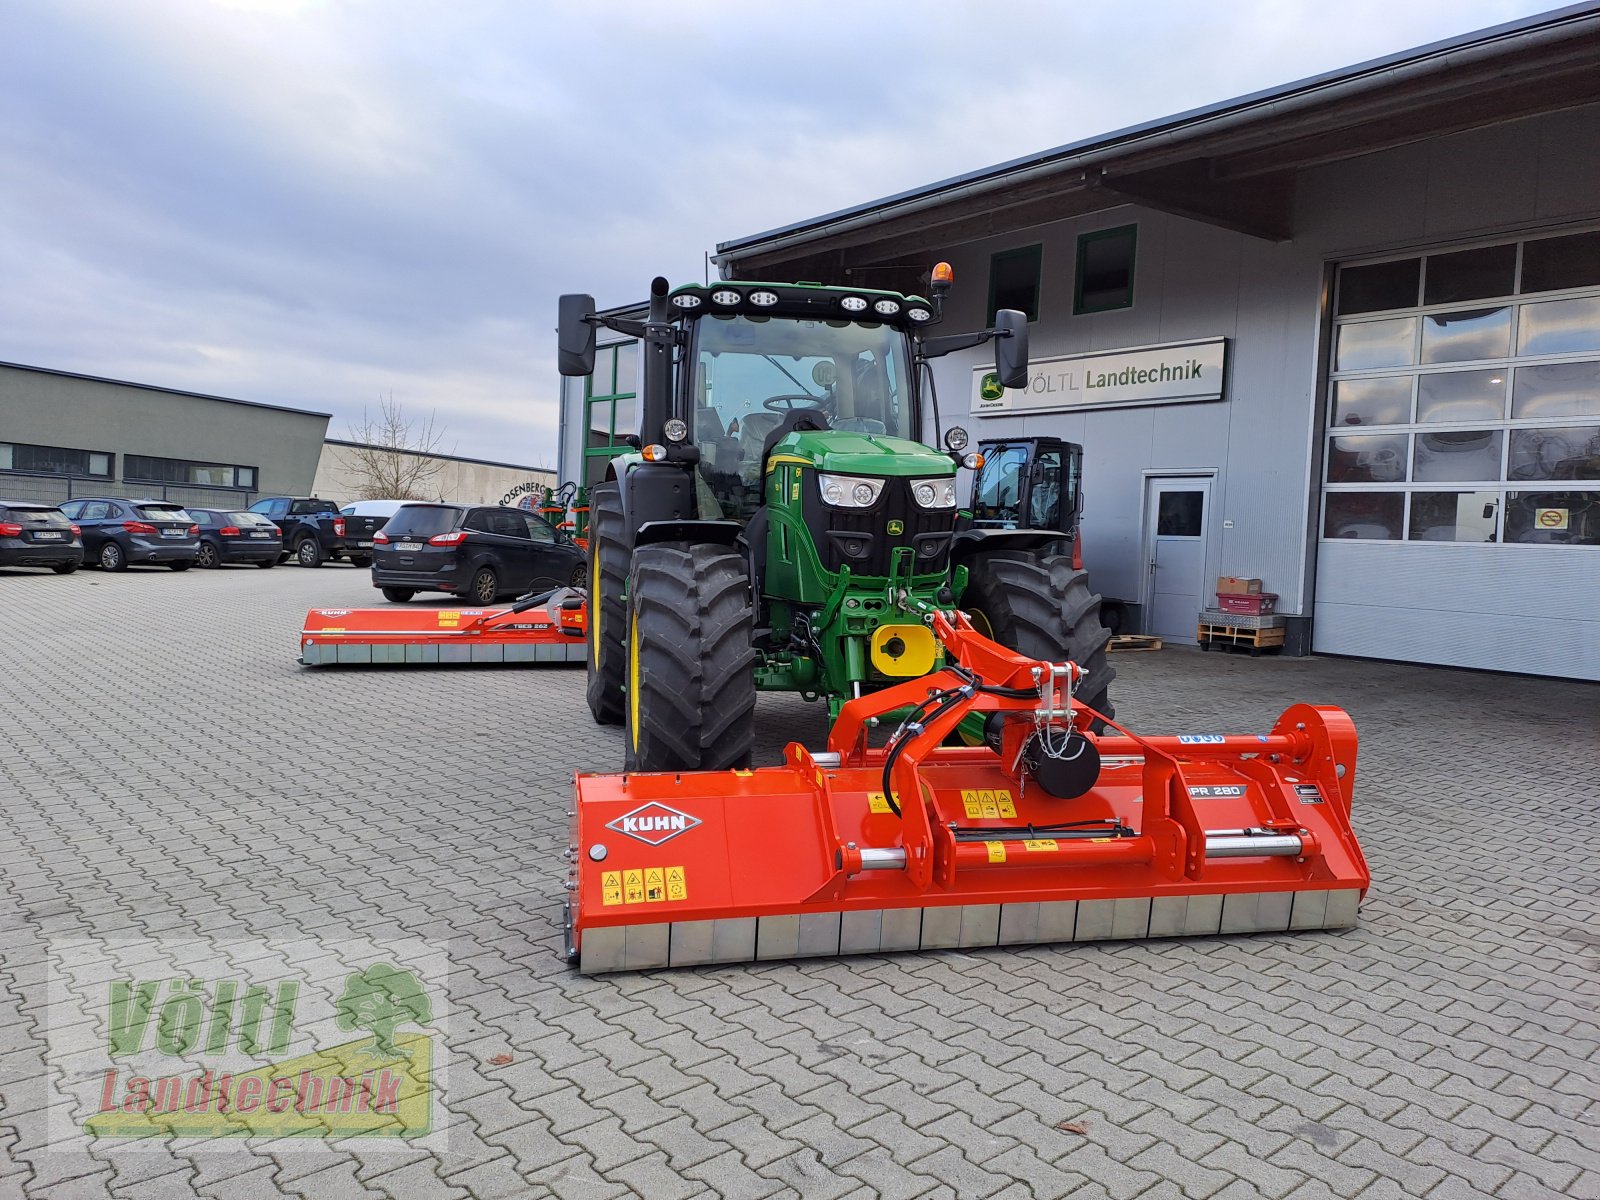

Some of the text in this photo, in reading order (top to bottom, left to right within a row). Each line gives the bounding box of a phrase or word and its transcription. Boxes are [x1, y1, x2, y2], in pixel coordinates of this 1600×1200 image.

[1086, 359, 1203, 389] Landtechnik
[499, 482, 546, 507] ROSENBERG
[1213, 786, 1240, 795] 280
[623, 815, 686, 832] KUHN
